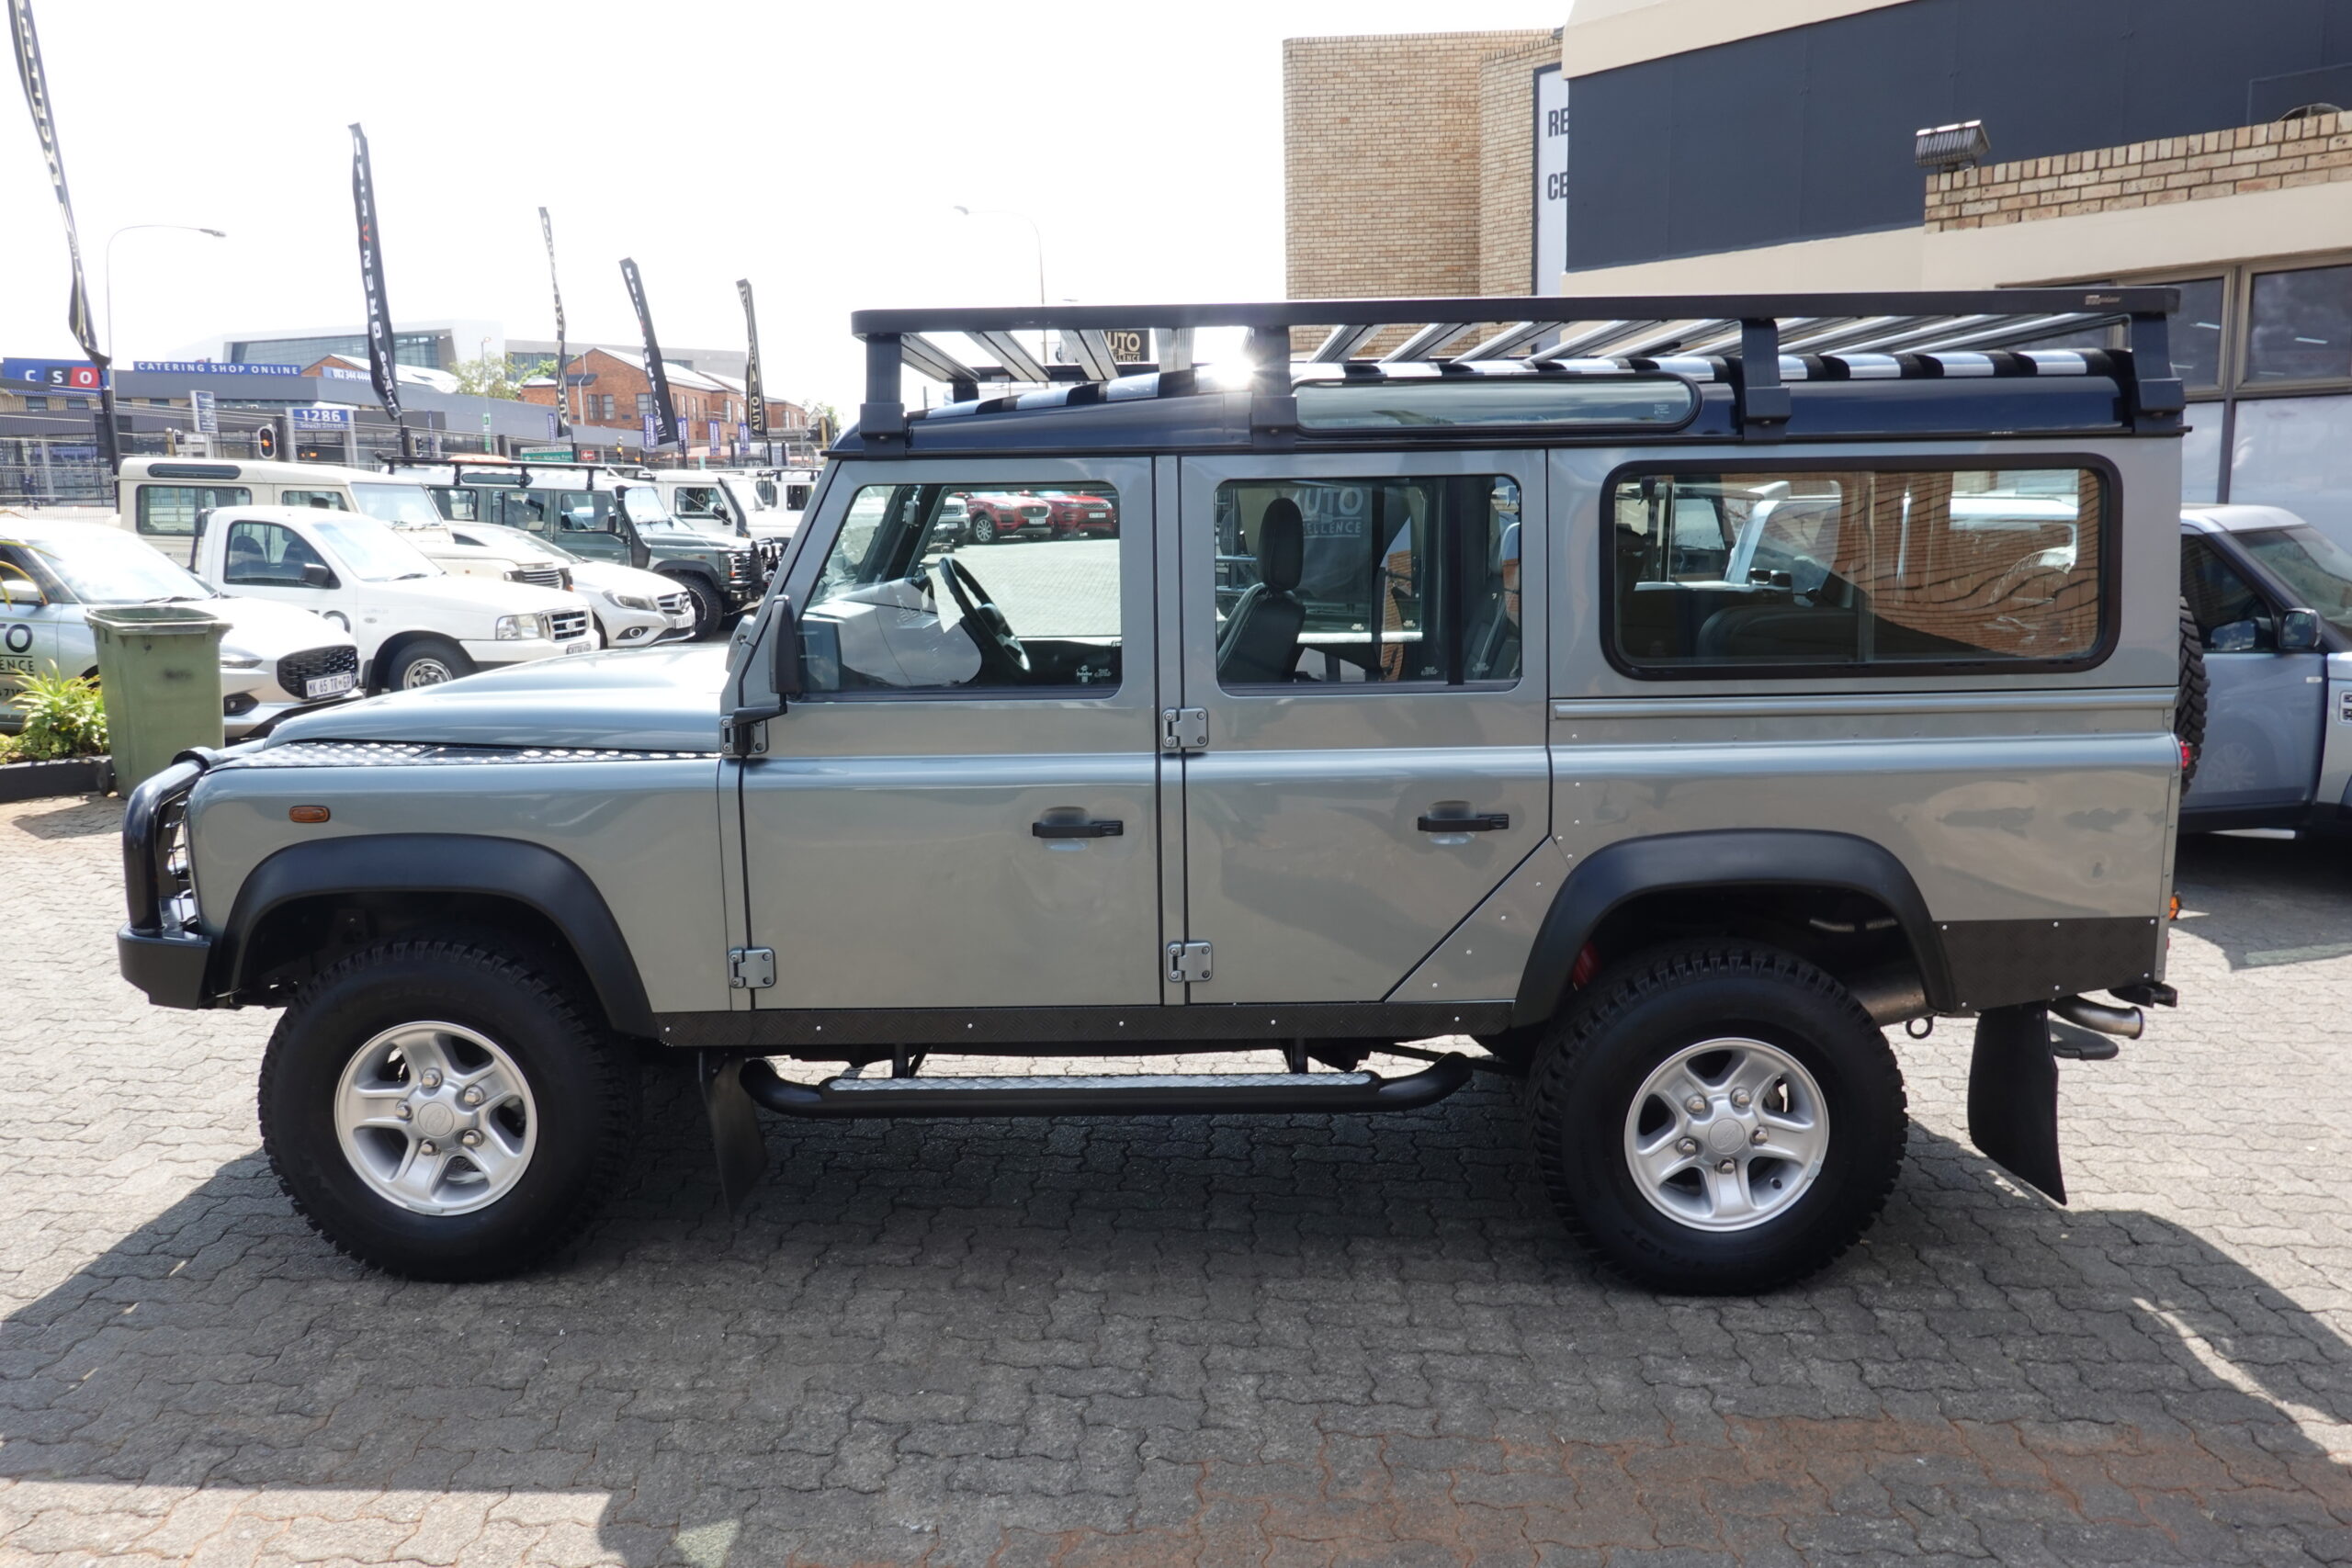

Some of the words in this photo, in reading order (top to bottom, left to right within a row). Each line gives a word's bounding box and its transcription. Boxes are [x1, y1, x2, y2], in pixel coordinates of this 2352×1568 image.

[1106, 332, 1141, 352] UTO
[138, 362, 205, 373] CATERING
[210, 364, 245, 374] SHOP
[251, 365, 299, 375] ONLINE
[301, 410, 342, 423] 1286
[752, 396, 761, 432] AUTO
[1304, 521, 1362, 534] ELLENCE
